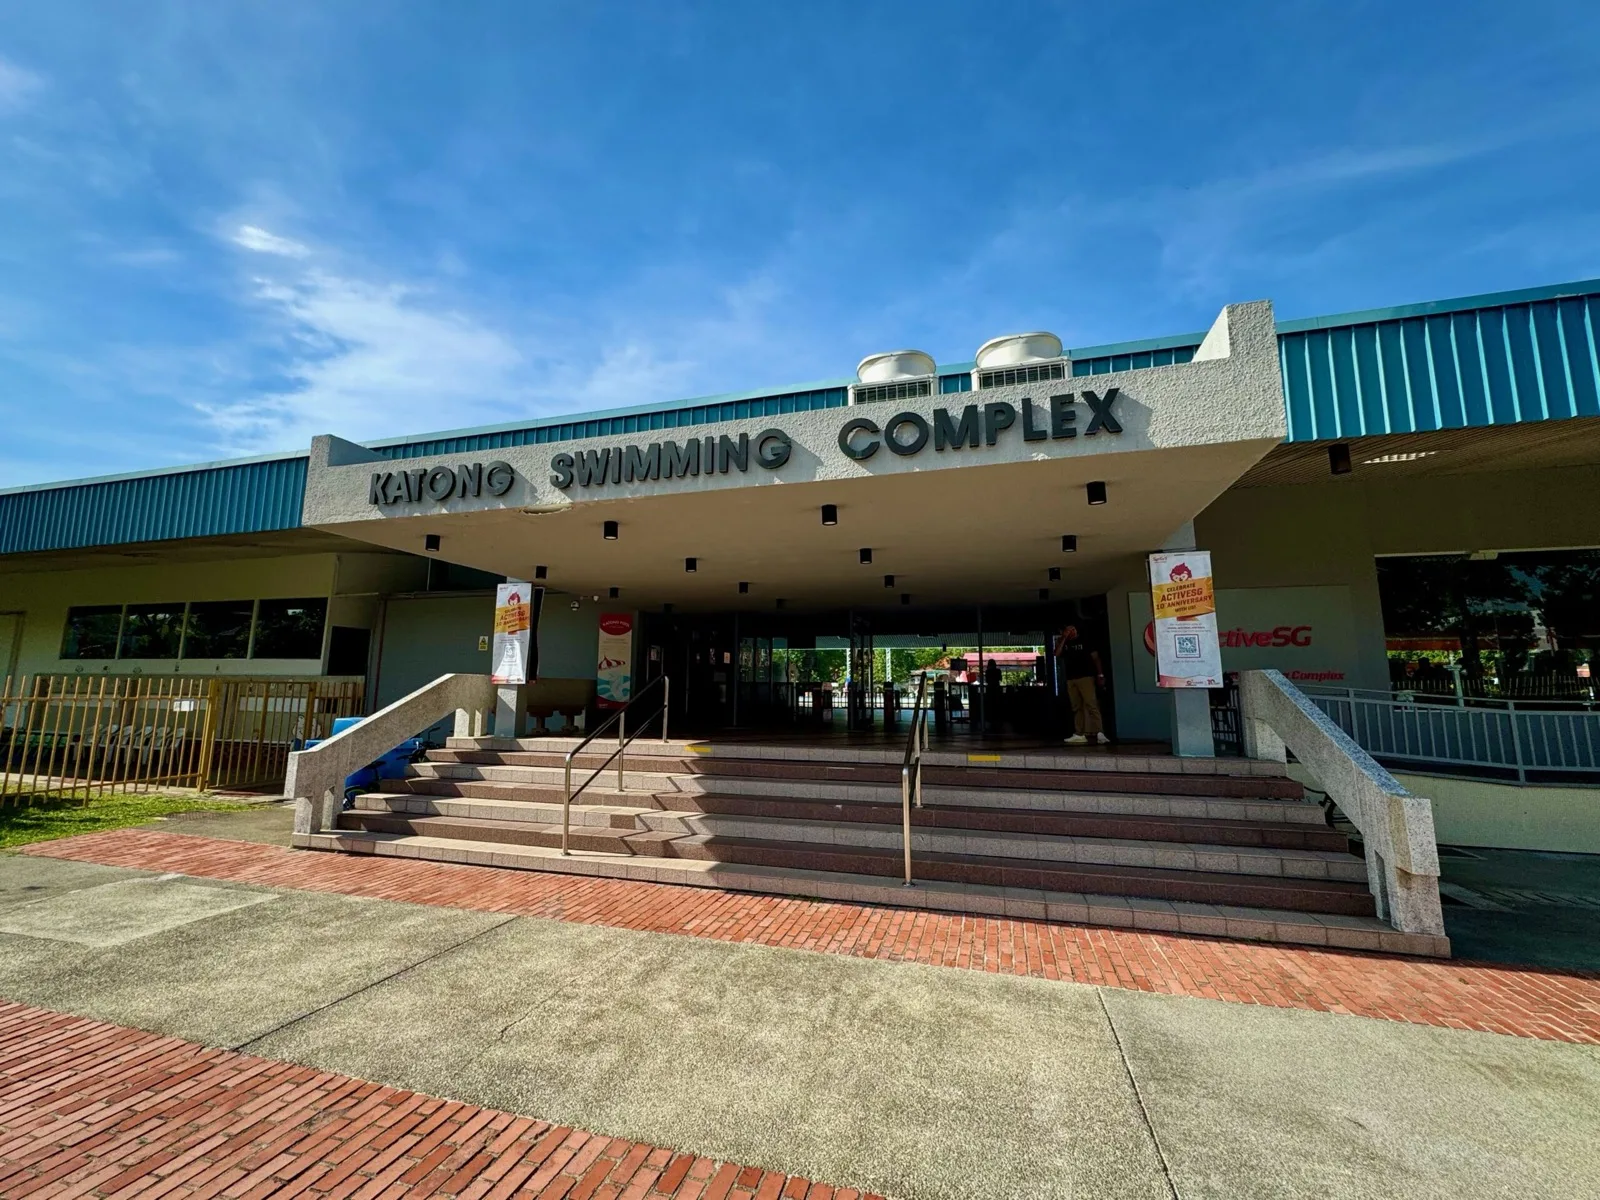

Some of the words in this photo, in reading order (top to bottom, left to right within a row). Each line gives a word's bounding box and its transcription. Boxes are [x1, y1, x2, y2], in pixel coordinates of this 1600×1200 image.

[369, 460, 514, 505] KATONG
[550, 428, 792, 489] SWIMMING
[838, 387, 1123, 461] COMPLEX
[1167, 582, 1196, 592] CELEBRATE
[1160, 588, 1203, 602] ACTIVESG
[1167, 594, 1213, 608] ANNIVERSARY
